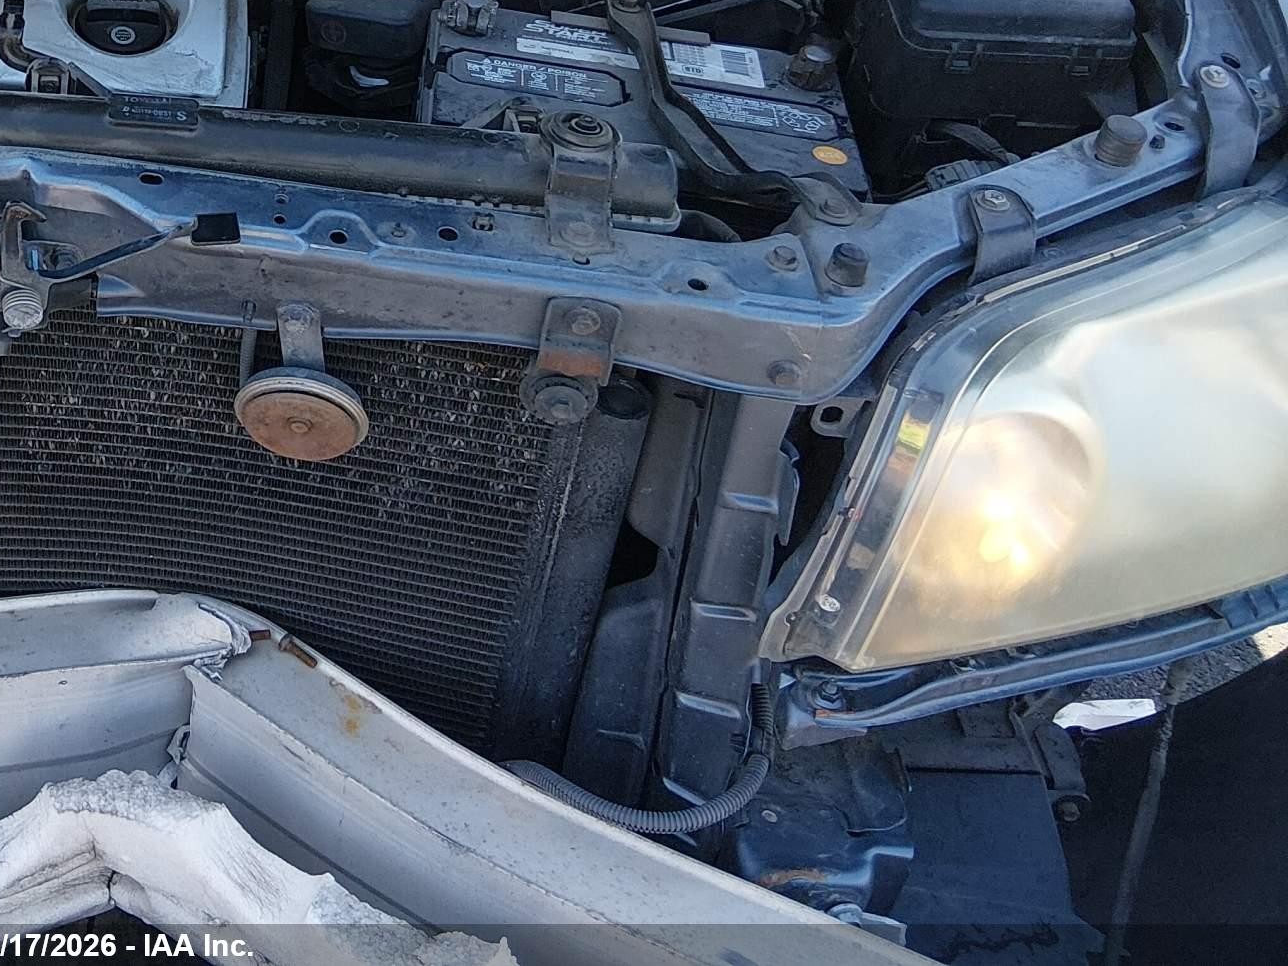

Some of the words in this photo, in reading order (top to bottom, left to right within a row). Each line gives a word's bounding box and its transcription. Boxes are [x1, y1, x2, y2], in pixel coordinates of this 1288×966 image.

[523, 23, 609, 42] START
[493, 59, 537, 71] DANGER
[547, 67, 587, 79] POISON
